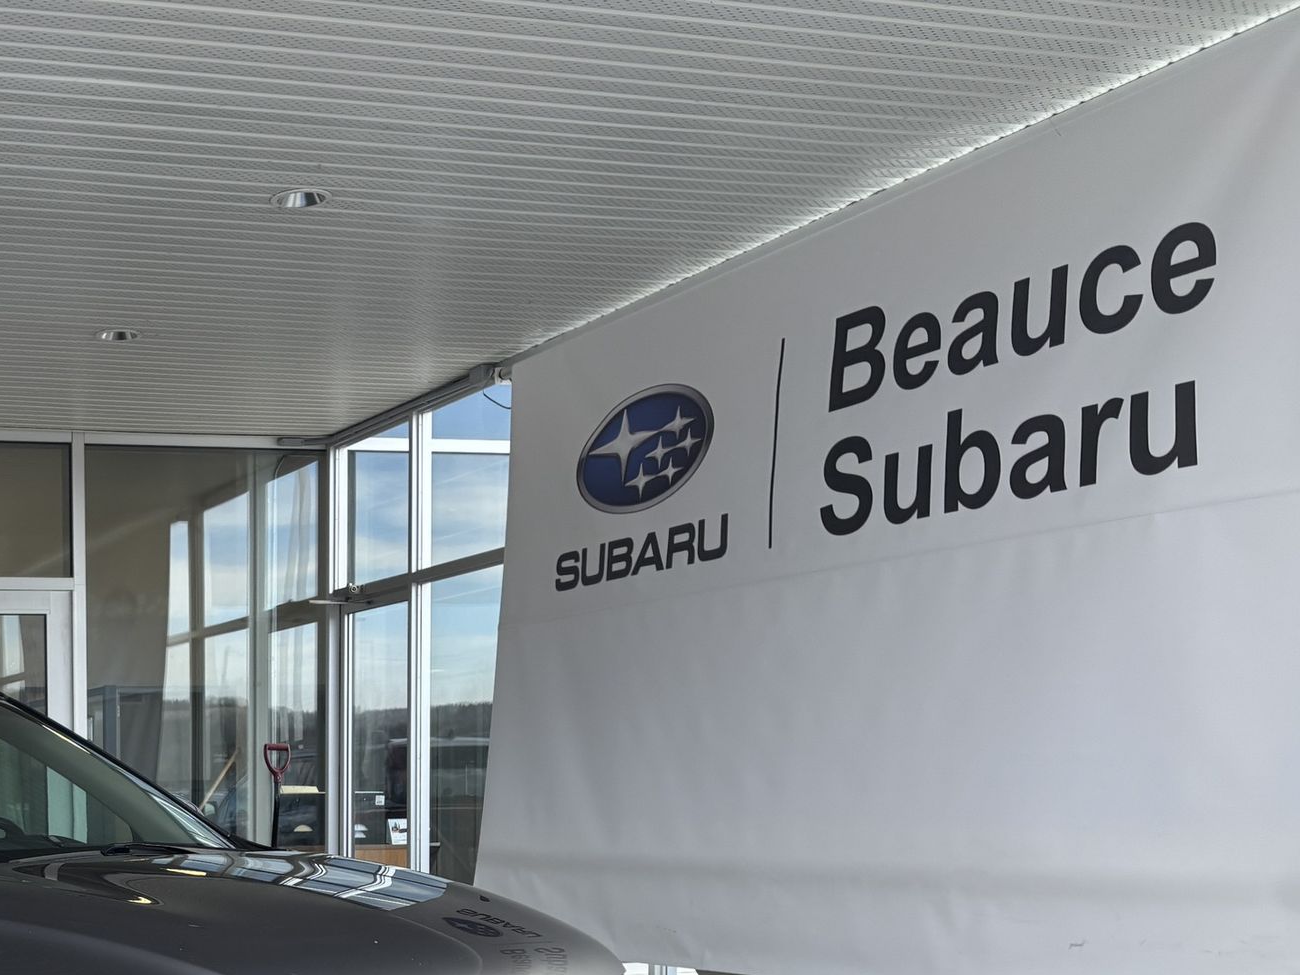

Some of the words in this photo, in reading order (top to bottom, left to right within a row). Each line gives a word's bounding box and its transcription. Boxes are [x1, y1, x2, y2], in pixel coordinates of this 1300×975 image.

[828, 222, 1217, 412] Beauce
[819, 379, 1199, 536] Subaru
[555, 513, 729, 592] SUBARU
